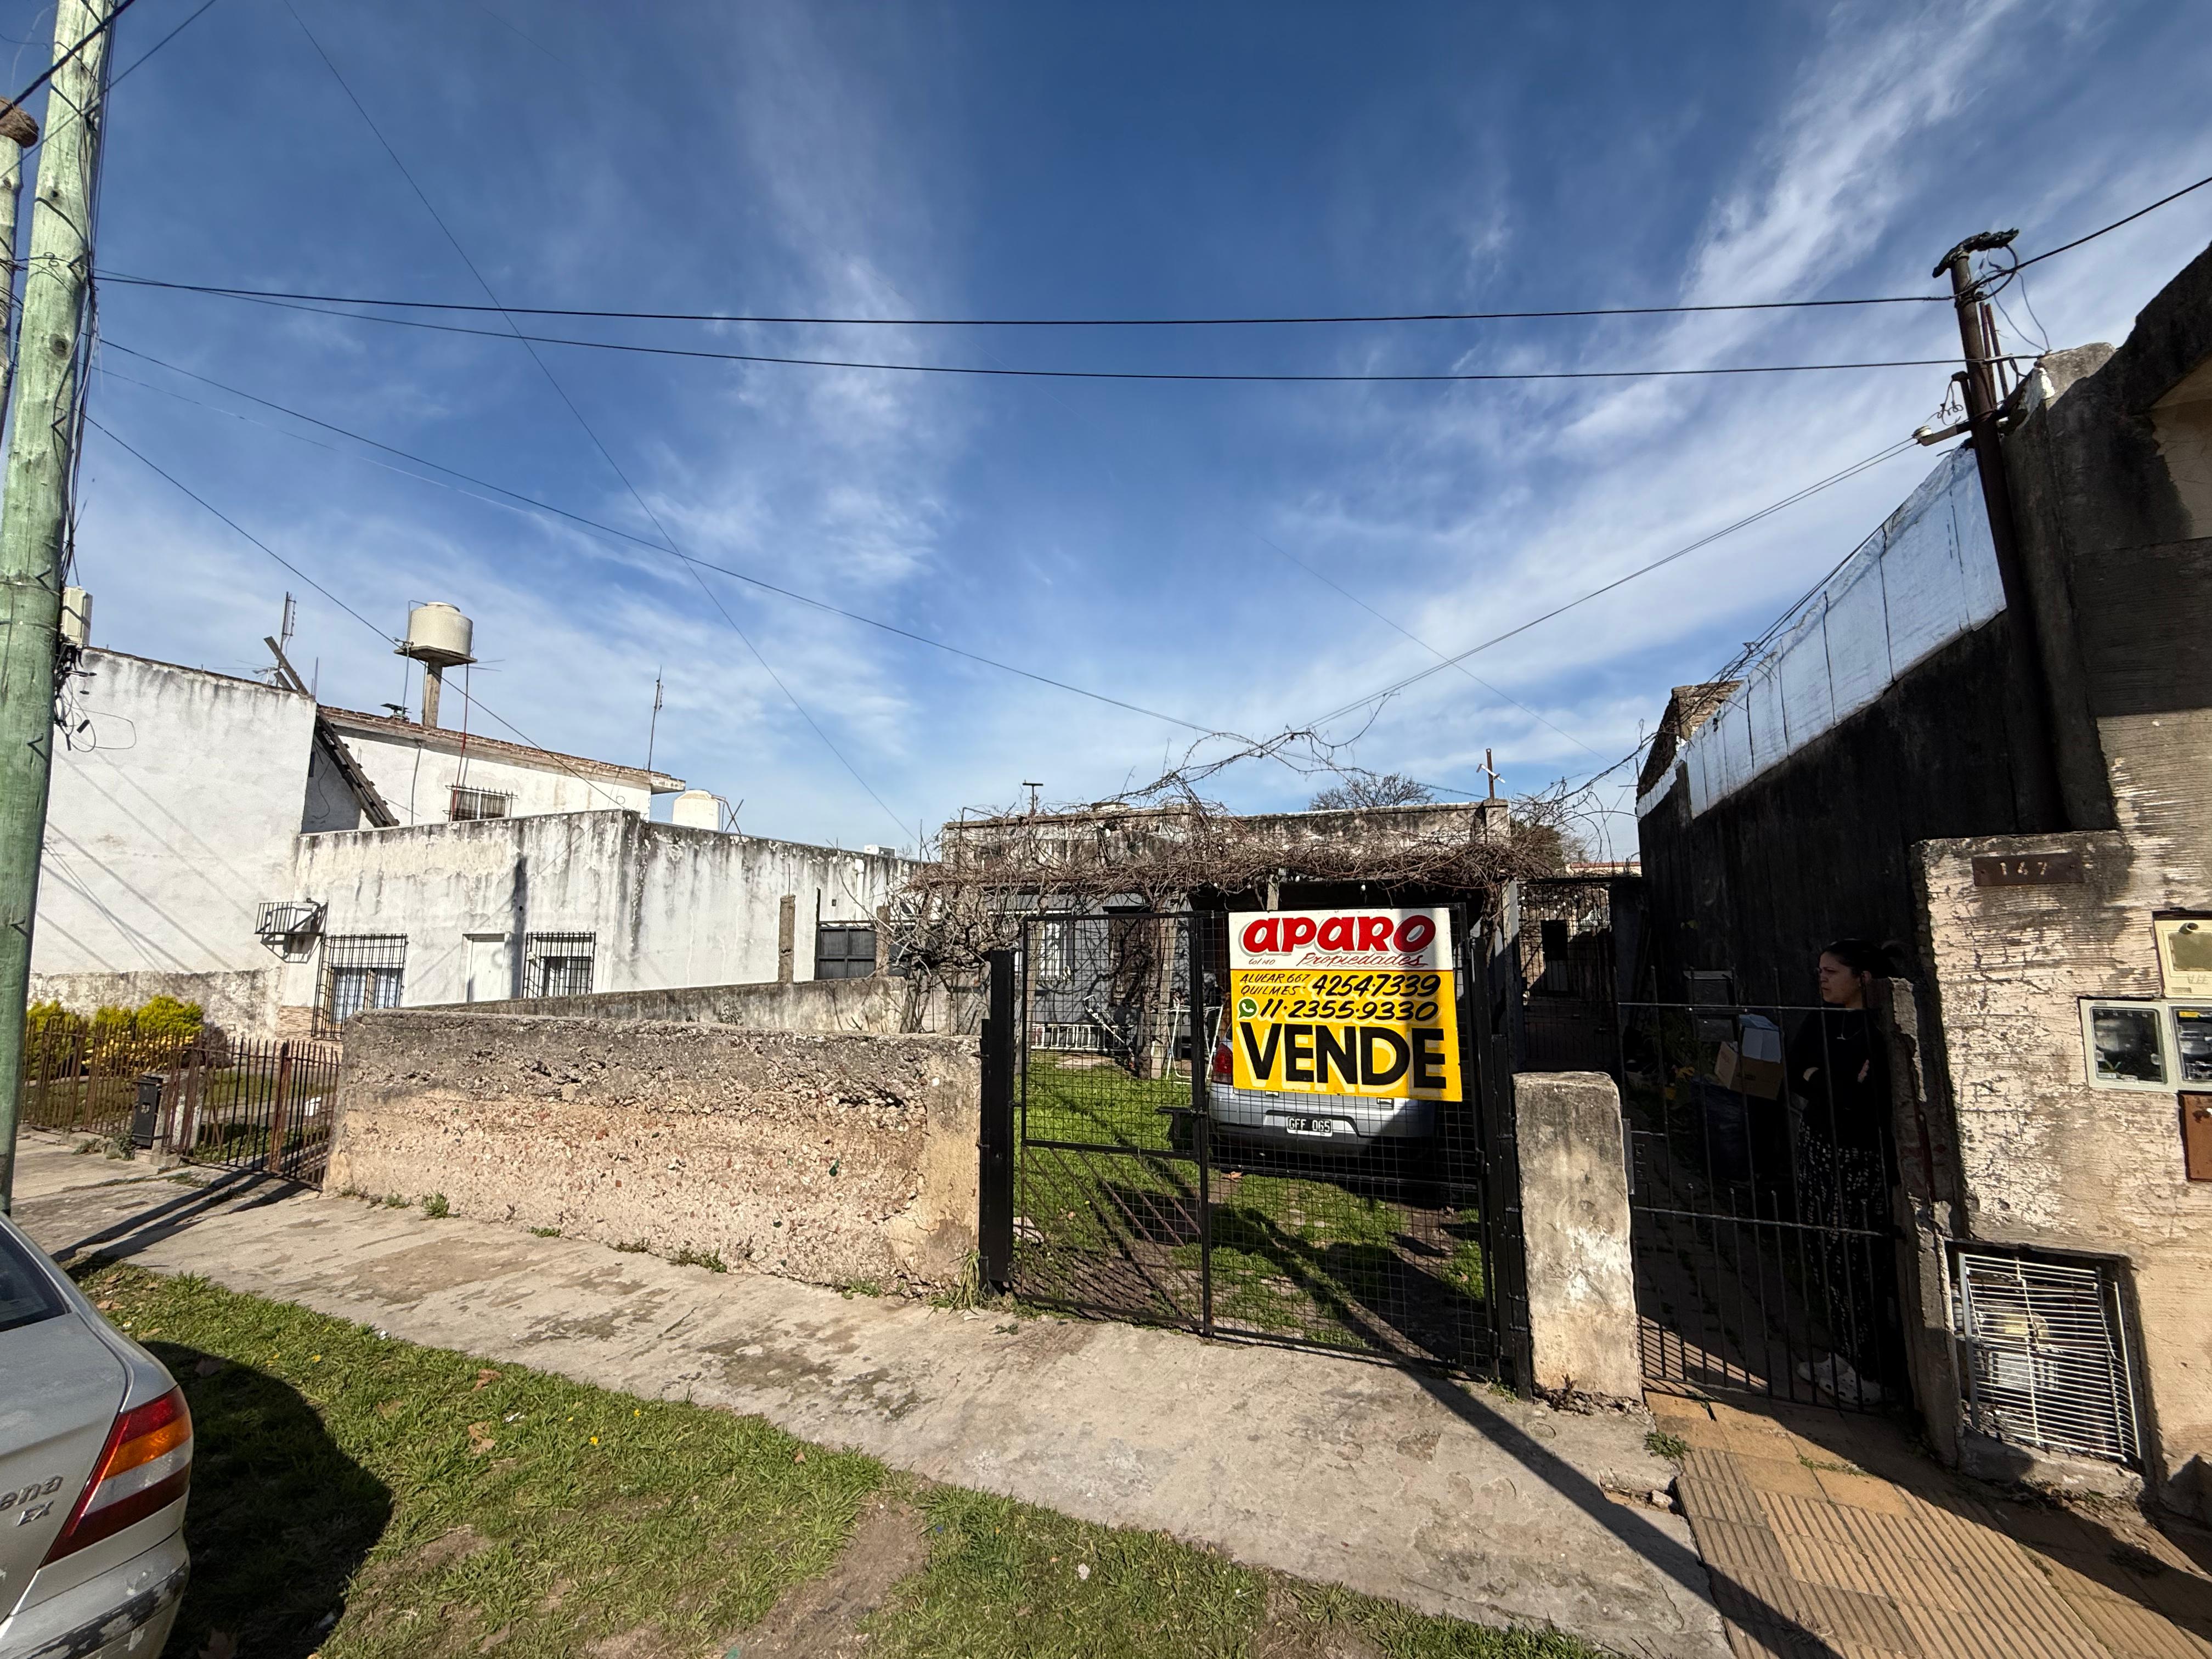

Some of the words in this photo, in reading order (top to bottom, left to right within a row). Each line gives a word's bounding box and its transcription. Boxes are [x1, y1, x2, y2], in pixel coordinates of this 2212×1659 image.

[1295, 952, 1429, 967] Propiedades
[1239, 973, 1285, 984] ALVEAR
[1286, 973, 1312, 983] 667
[1240, 985, 1301, 996] QUILMES
[1239, 1022, 1447, 1089] VENDE
[1289, 1118, 1307, 1130] GFF
[1312, 1119, 1330, 1132] 065
[16, 1500, 54, 1526] EX
